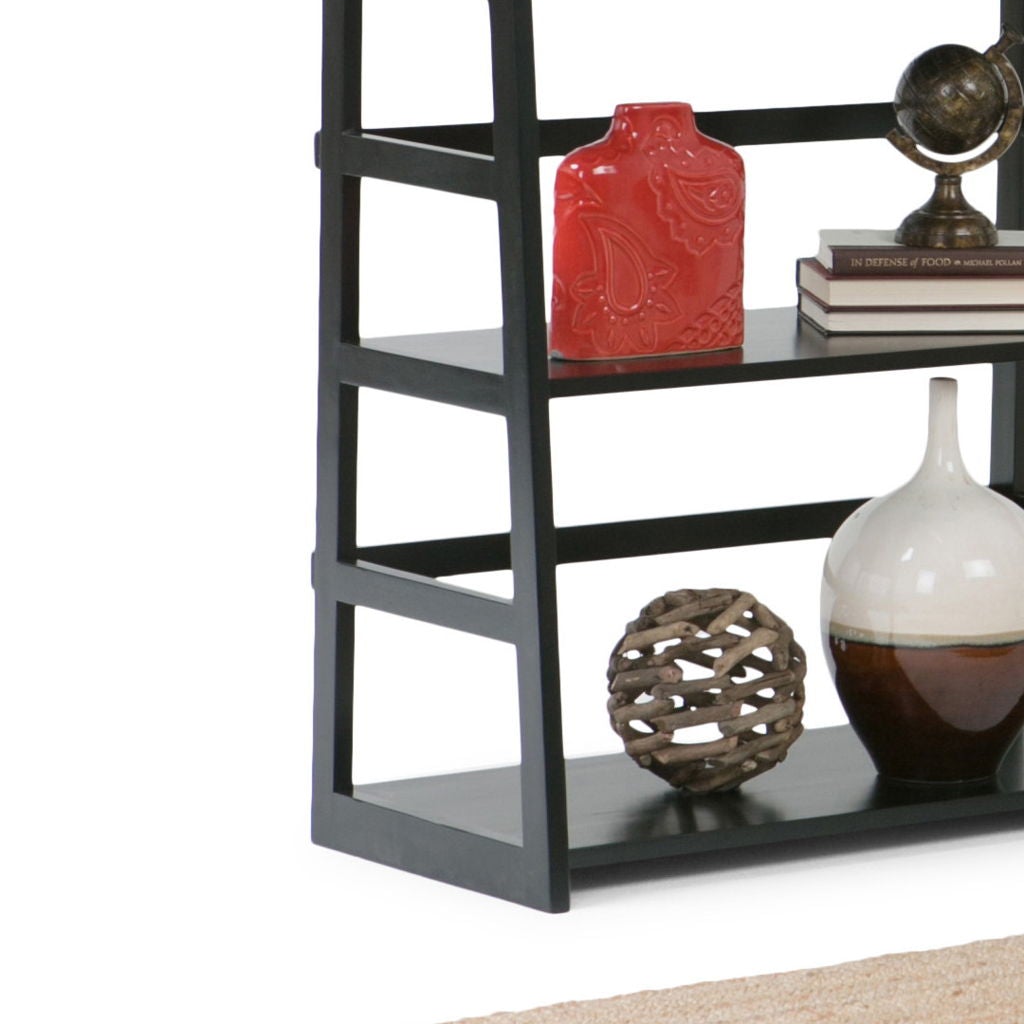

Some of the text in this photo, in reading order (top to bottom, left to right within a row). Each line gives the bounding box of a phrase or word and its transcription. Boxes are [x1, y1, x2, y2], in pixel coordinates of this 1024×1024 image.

[851, 257, 1022, 268] IN DEFENSE of FOOD MICHAEL POLLAN
